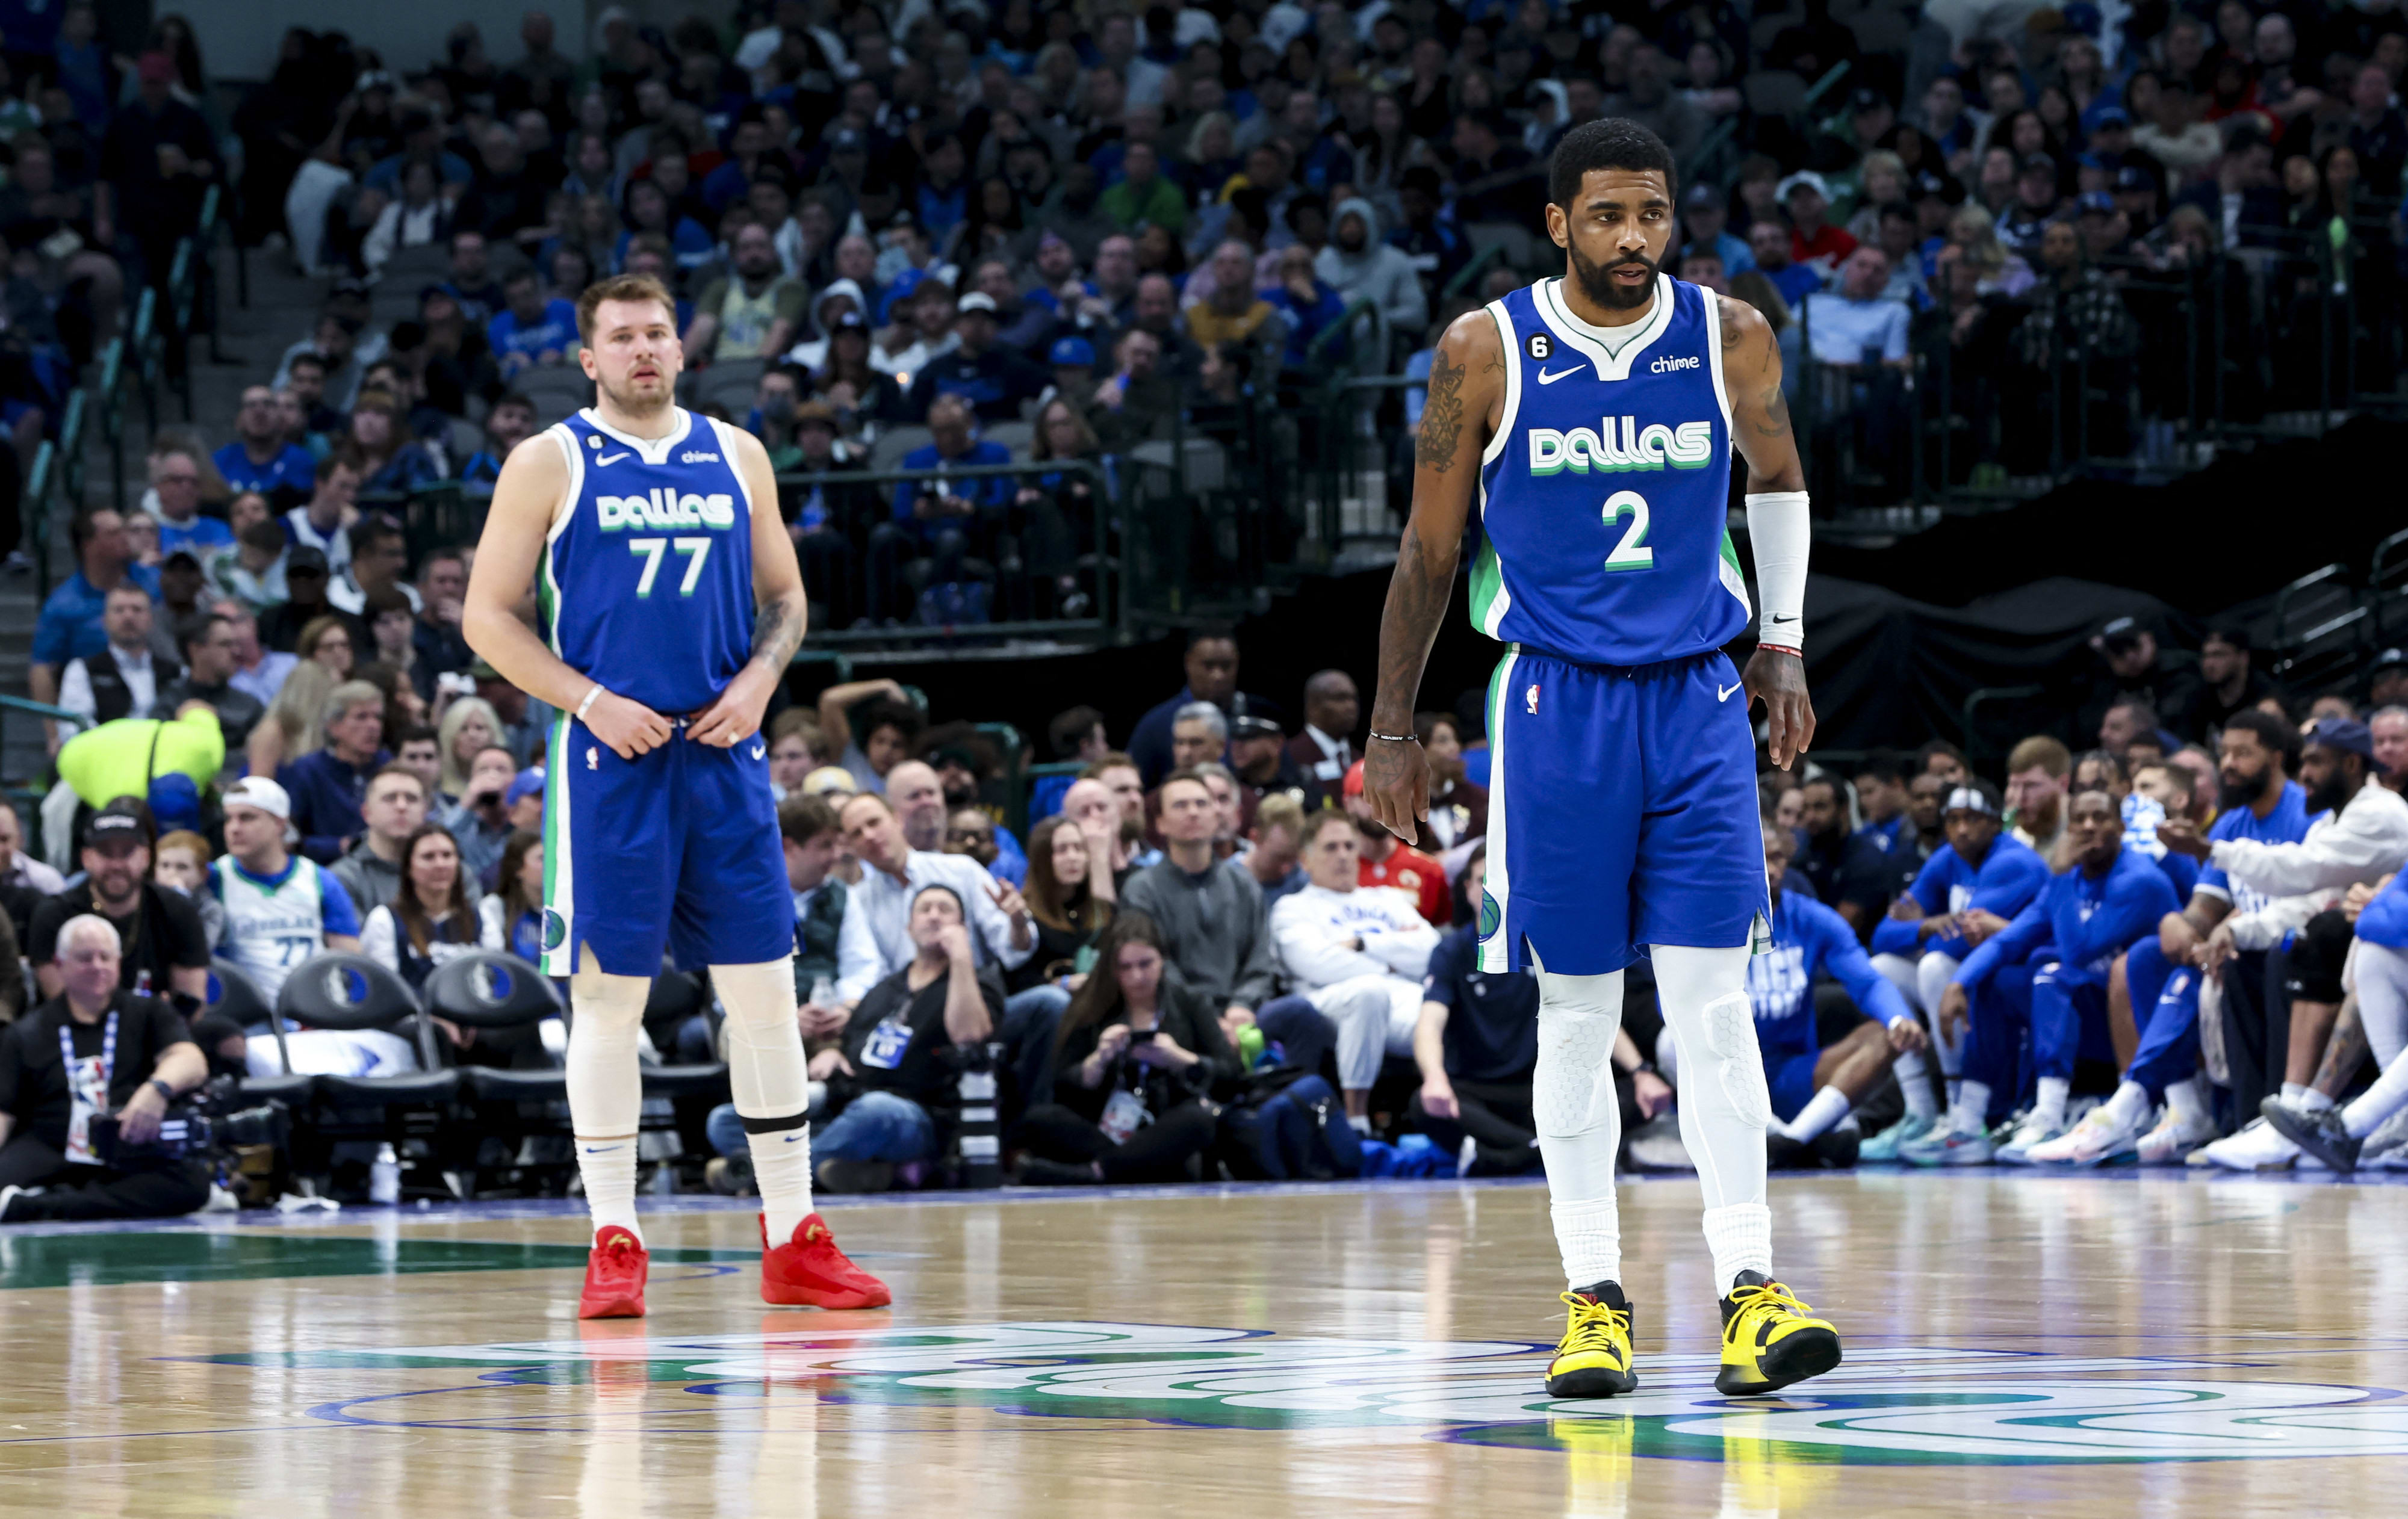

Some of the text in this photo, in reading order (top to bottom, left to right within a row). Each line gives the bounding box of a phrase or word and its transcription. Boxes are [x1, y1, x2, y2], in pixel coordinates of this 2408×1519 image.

[1531, 336, 1548, 357] 6
[1650, 356, 1700, 374] chime
[681, 450, 719, 464] chime
[1528, 415, 1712, 476] Dallas
[595, 487, 734, 531] Dallas
[1601, 490, 1653, 572] 2
[628, 537, 712, 599] 77
